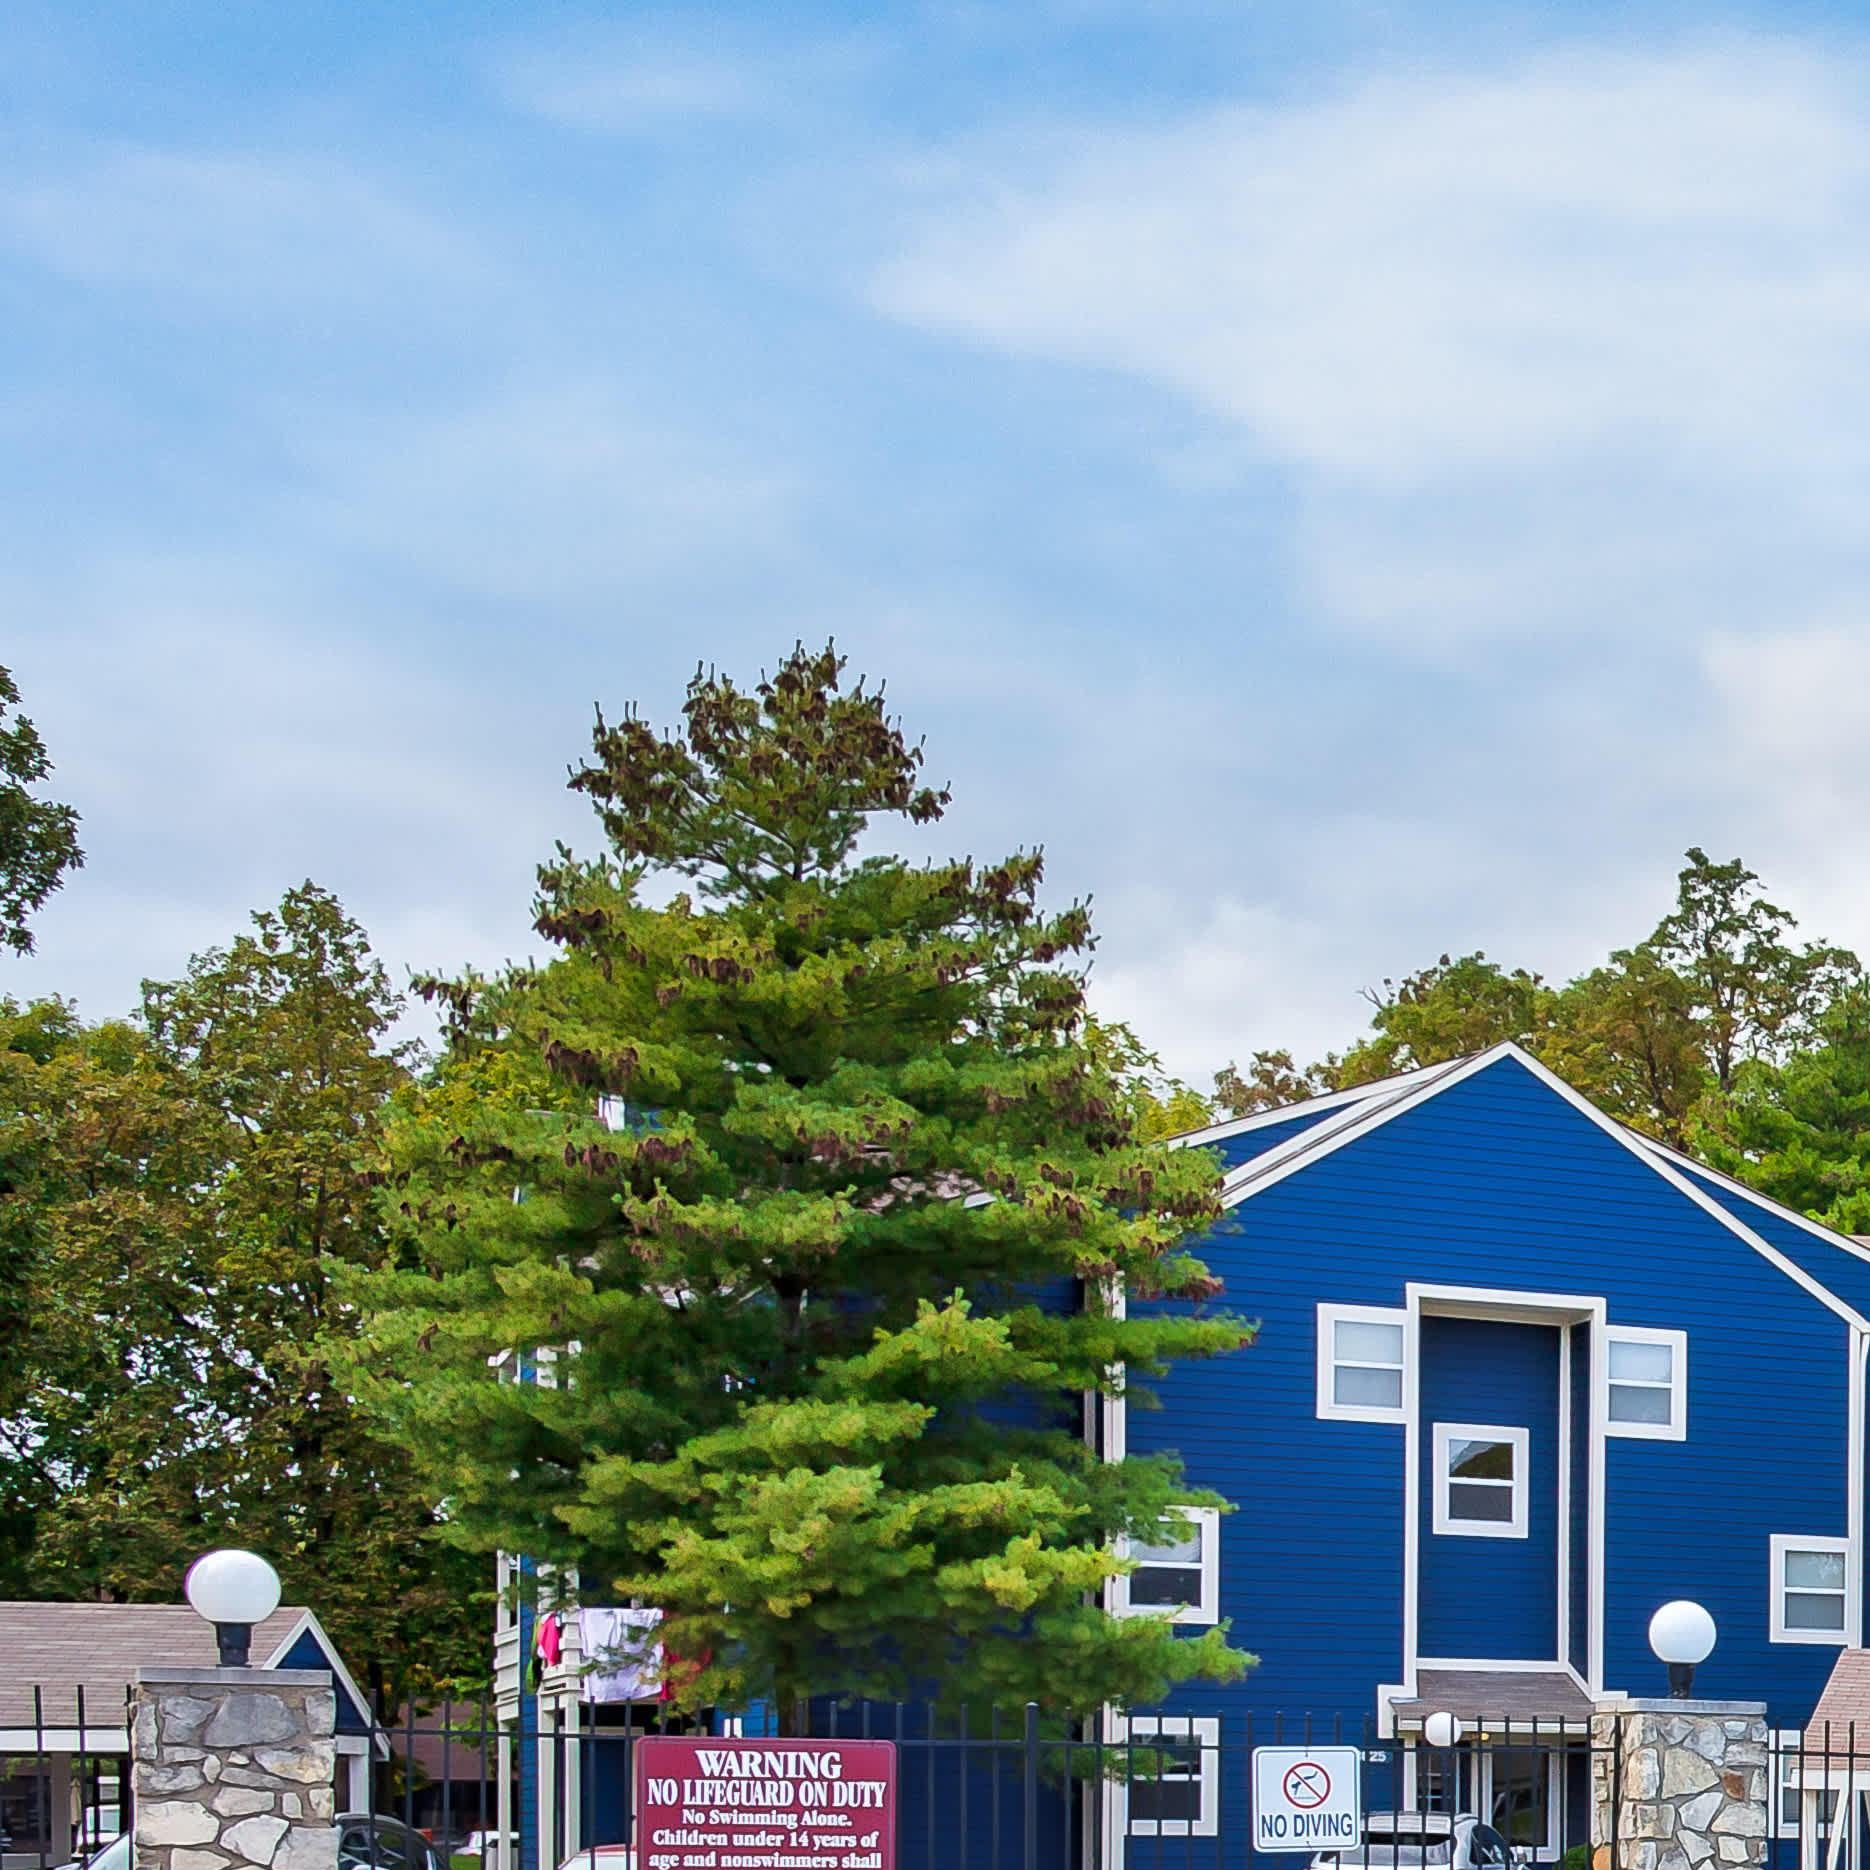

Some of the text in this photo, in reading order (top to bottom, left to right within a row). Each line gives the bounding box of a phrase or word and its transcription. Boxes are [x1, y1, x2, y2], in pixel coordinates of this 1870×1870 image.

[695, 1750, 842, 1779] WARNING
[648, 1778, 887, 1807] NO LIFEGUARD ON DUTY
[682, 1809, 853, 1829] No Swimming Alone.
[1261, 1813, 1353, 1838] NO DIVING
[652, 1829, 880, 1851] Children under 14 years of
[648, 1851, 882, 1870] age and nonswimmers shall
